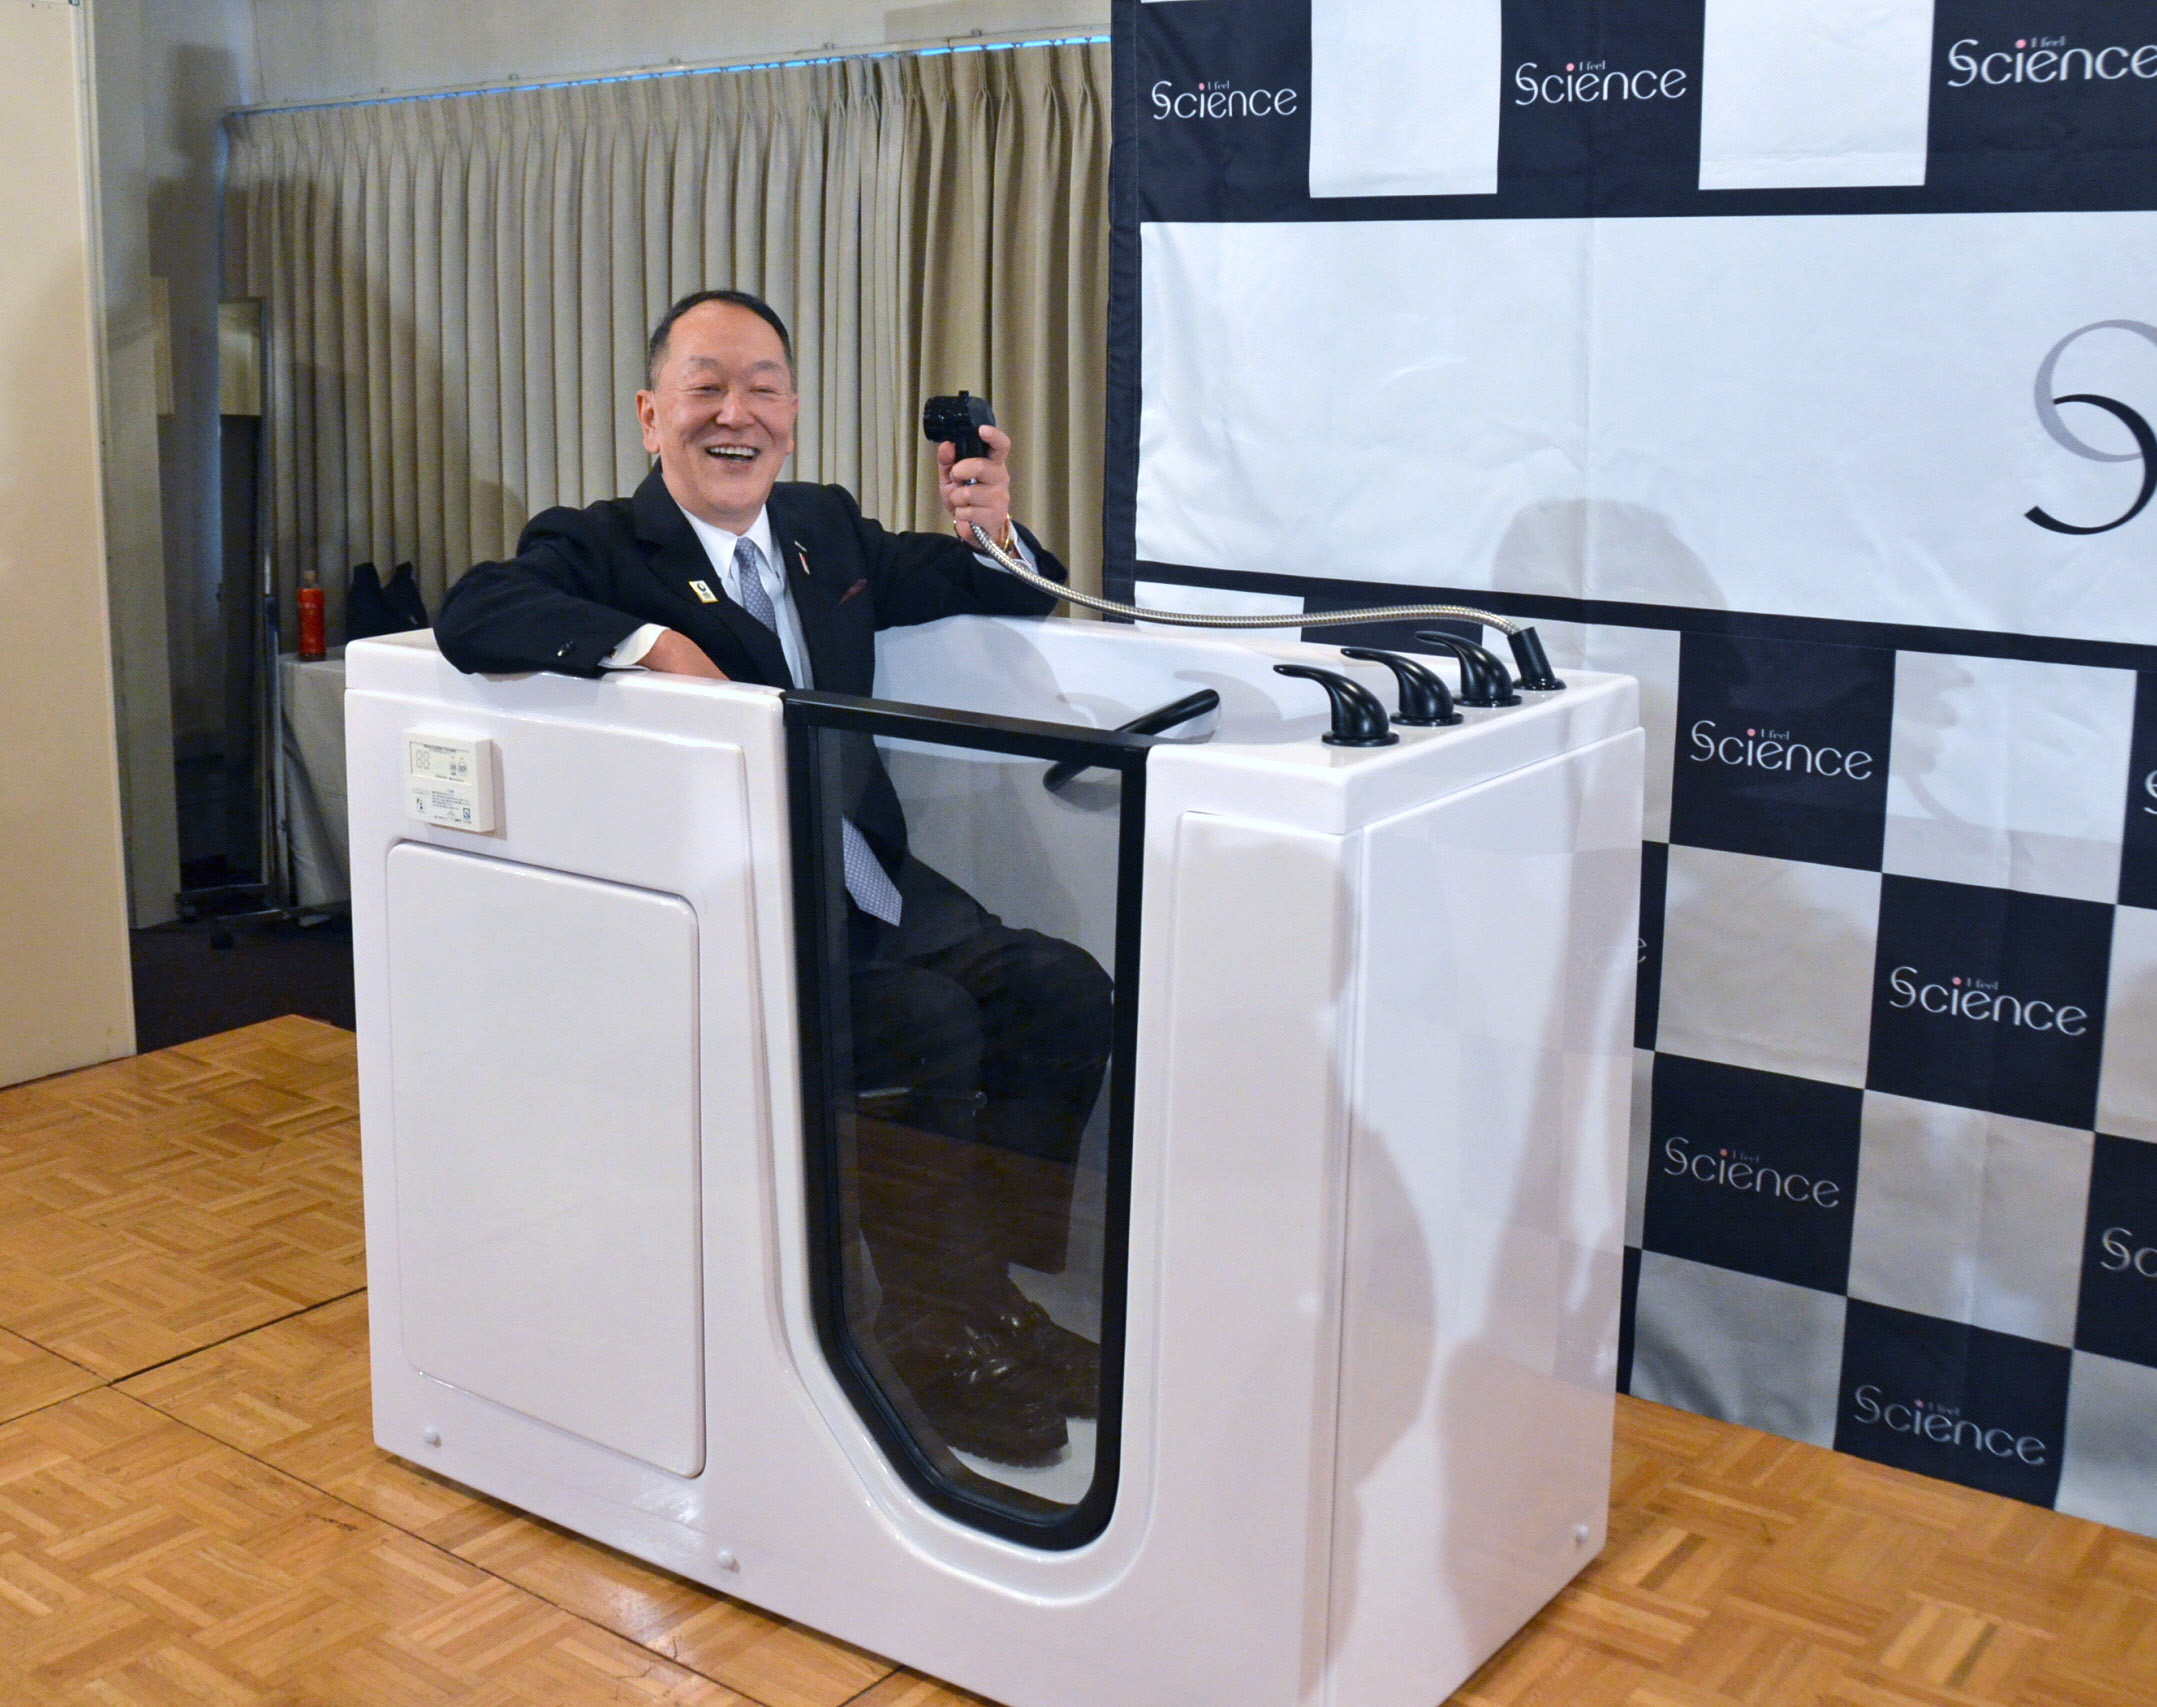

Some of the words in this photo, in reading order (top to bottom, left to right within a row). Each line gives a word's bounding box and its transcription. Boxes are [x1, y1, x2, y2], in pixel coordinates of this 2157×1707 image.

[1214, 80, 1230, 90] feel
[1515, 62, 1687, 106] Science
[1586, 60, 1606, 71] feel
[1947, 38, 2157, 87] Science
[1152, 80, 1298, 120] Science
[1690, 720, 1873, 780] Science
[1769, 728, 1790, 741] feel
[1889, 966, 2088, 1036] Science
[1664, 1136, 1840, 1208] Science
[1853, 1384, 2046, 1466] Science
